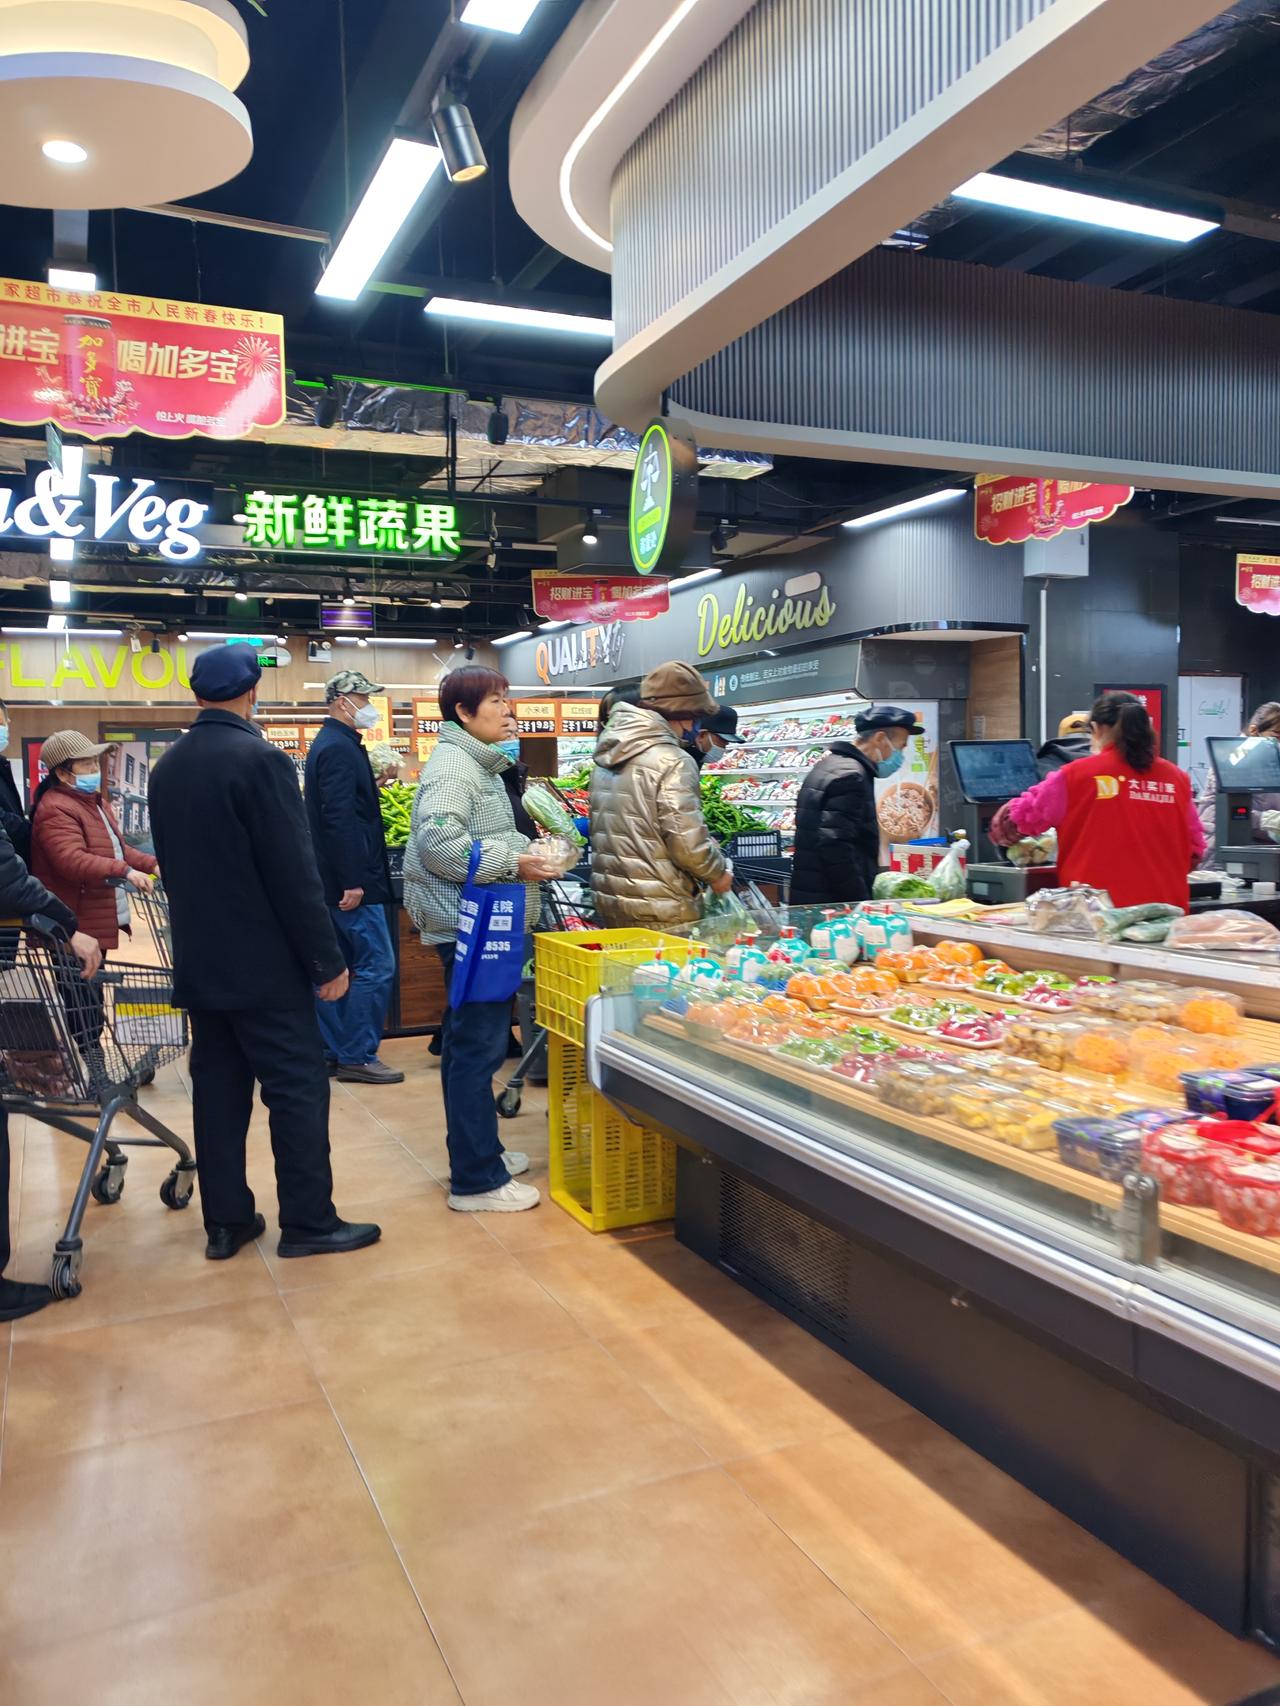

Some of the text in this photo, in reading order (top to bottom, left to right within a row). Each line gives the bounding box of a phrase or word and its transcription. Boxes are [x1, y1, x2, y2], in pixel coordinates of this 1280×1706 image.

[117, 339, 239, 385] 喝加多宝
[244, 490, 461, 553] 新鲜蔬果
[550, 586, 593, 601] 招财进宝
[697, 582, 836, 656] Delicious
[536, 624, 610, 685] QUALITY
